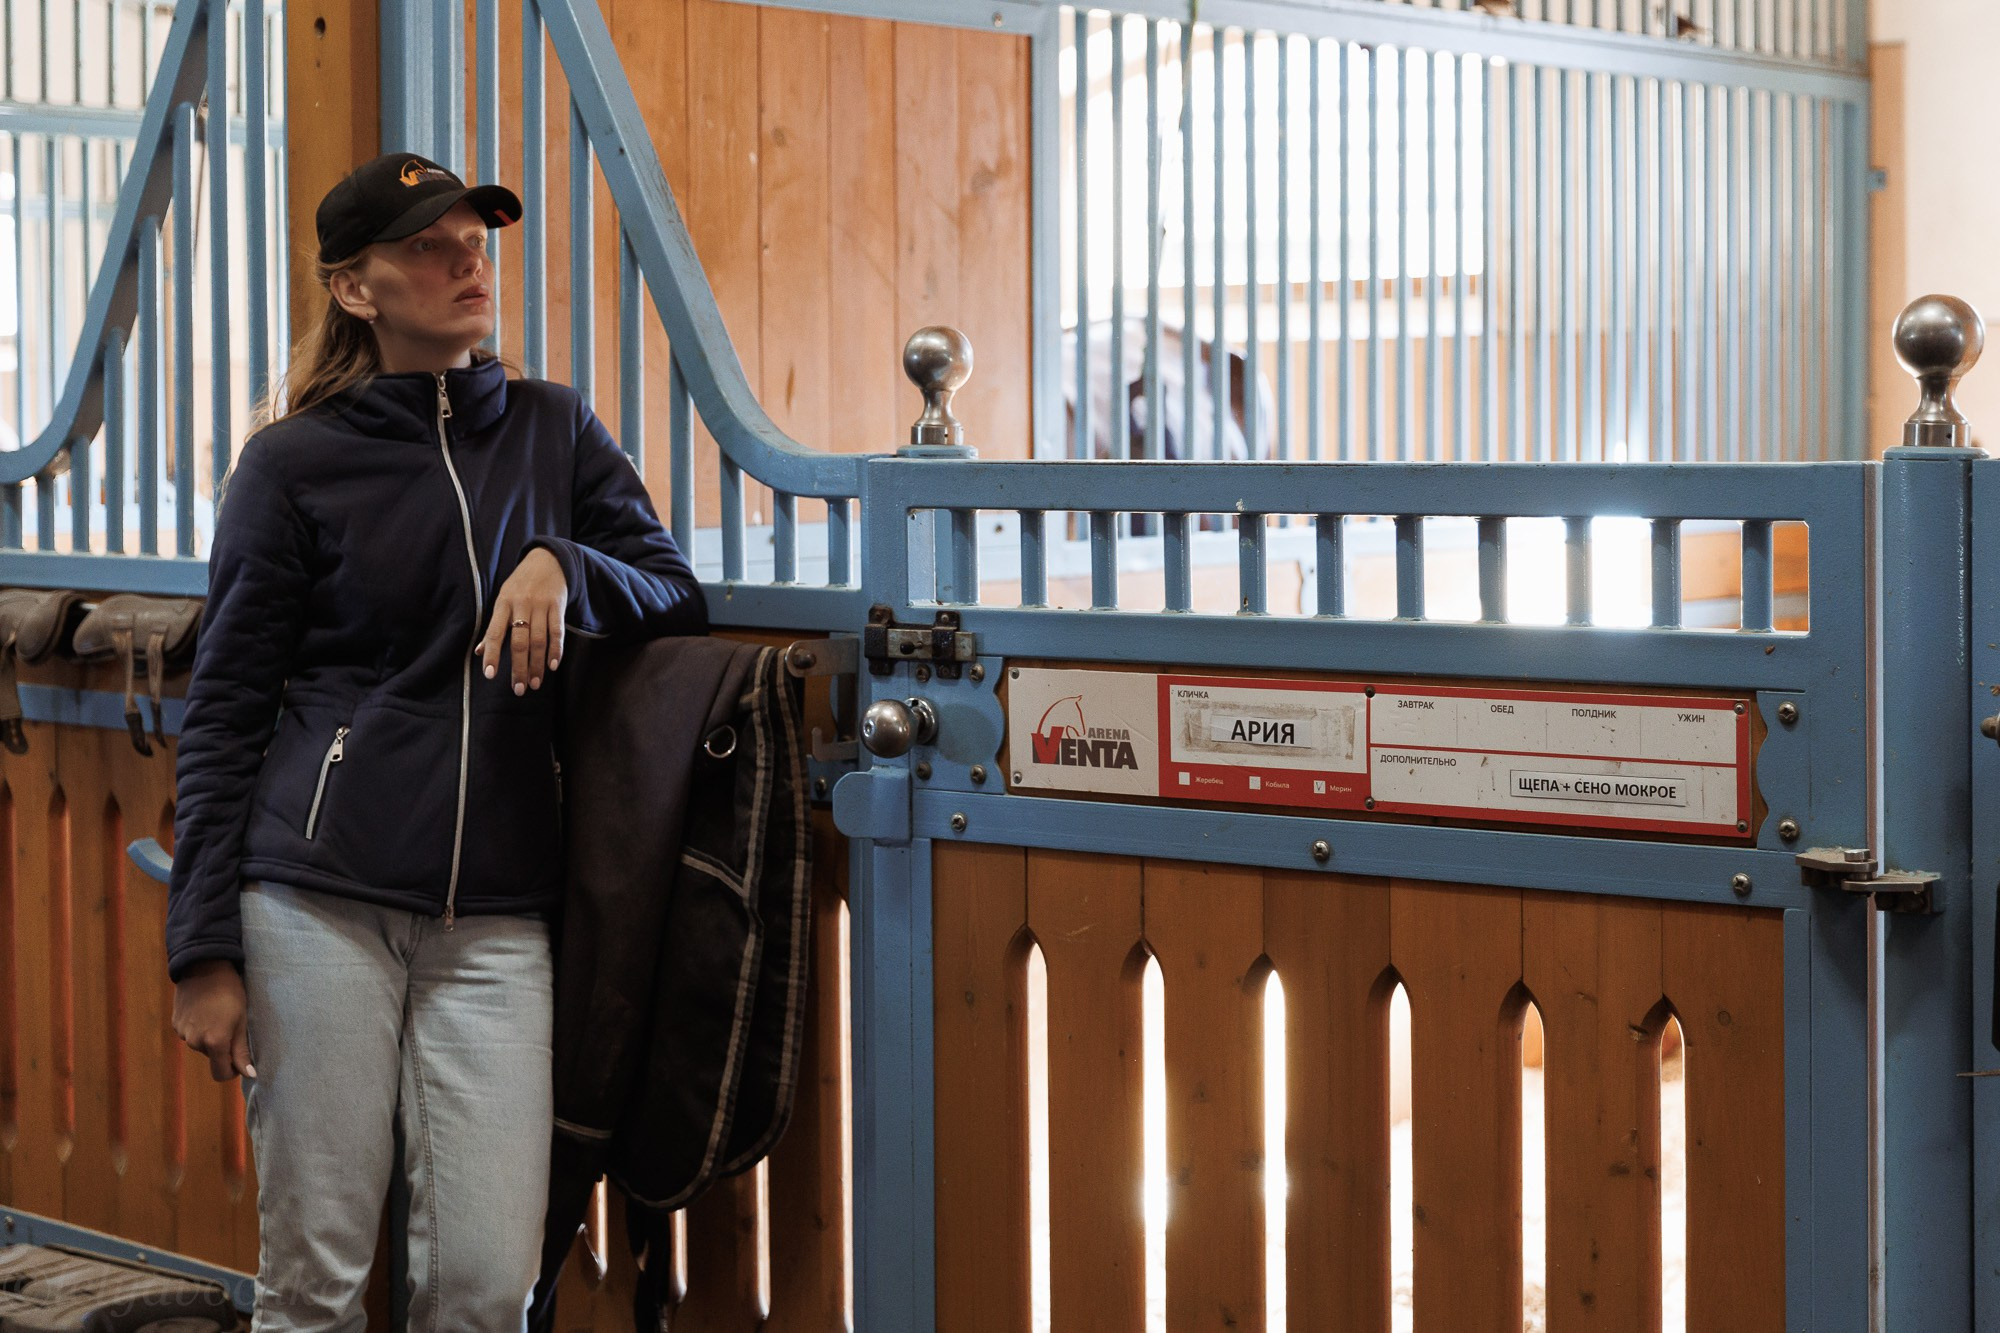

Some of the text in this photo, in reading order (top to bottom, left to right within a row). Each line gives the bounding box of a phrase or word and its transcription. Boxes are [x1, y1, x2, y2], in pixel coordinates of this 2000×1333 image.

[1177, 690, 1210, 699] КЛИЧКА
[1397, 700, 1435, 710] ЗАВТРАК
[1490, 704, 1515, 715] ОБЕД
[1571, 708, 1617, 719] ПОЛДНИК
[1677, 713, 1706, 723] УЖИН
[1087, 727, 1131, 741] ARENA
[1230, 719, 1296, 745] АРИЯ
[1031, 726, 1139, 770] VENTA
[1380, 754, 1457, 767] ДОПОЛНИТЕЛЬНО
[1195, 776, 1225, 786] Жеребец
[1265, 780, 1291, 790] Кобыла
[1329, 785, 1353, 794] Мерин
[1518, 777, 1560, 792] ЩЕПА
[1574, 781, 1611, 795] СЕНО
[1615, 783, 1677, 799] МОКРОЕ
